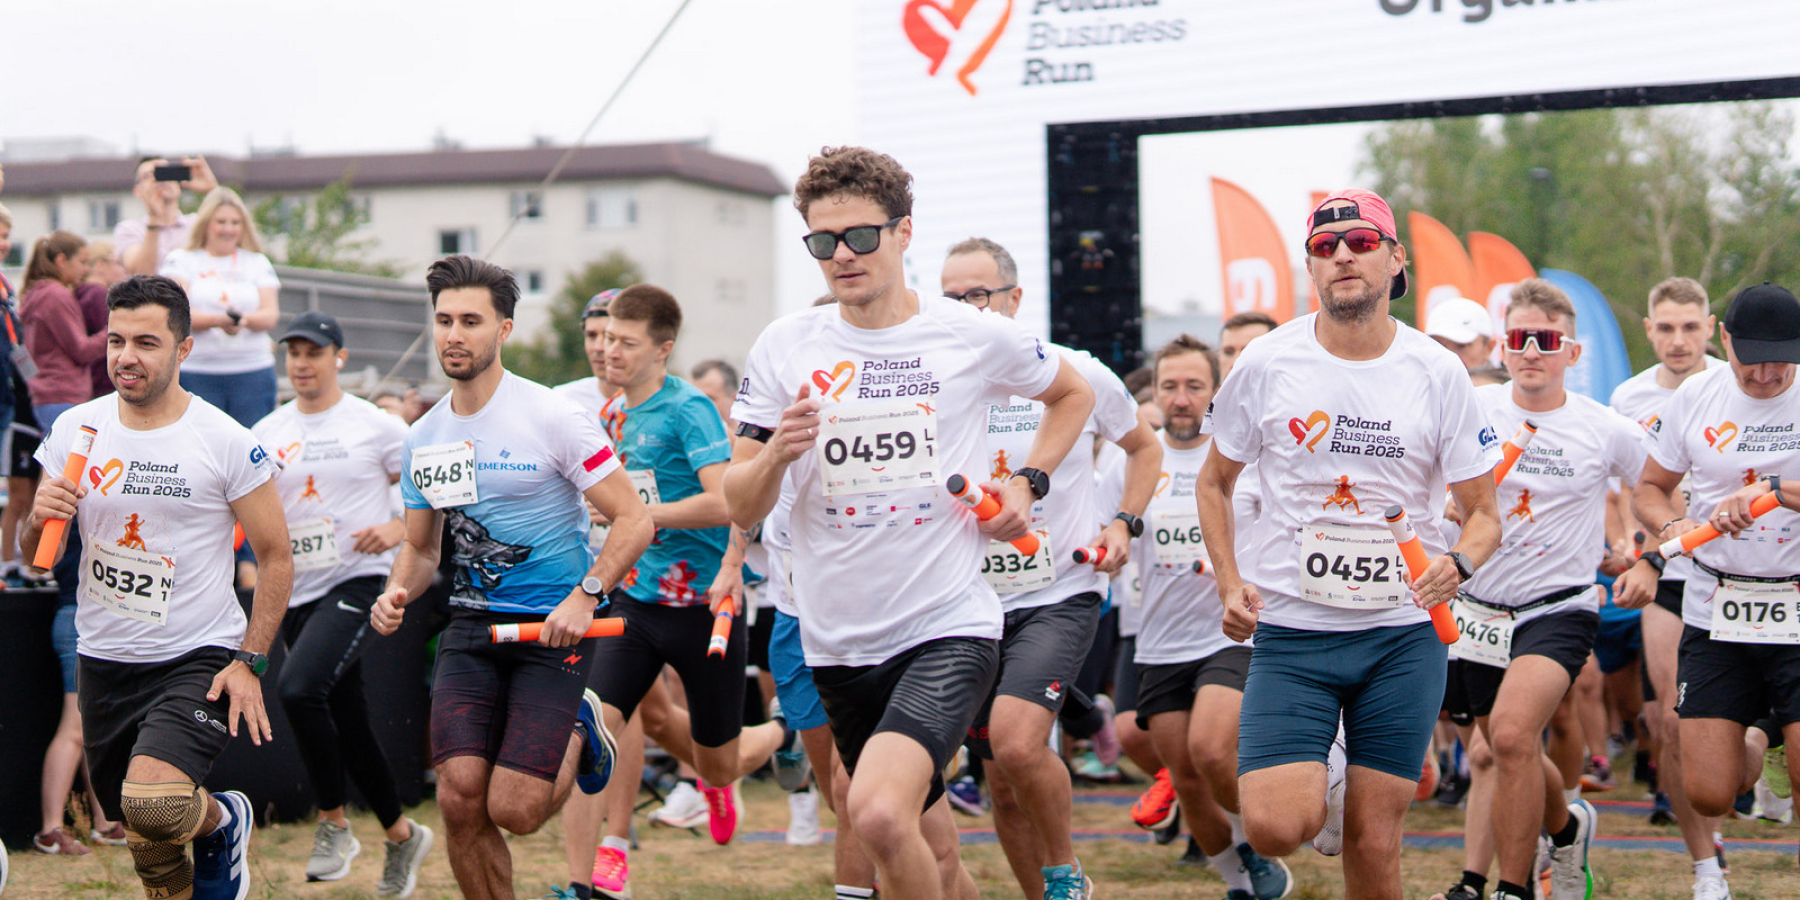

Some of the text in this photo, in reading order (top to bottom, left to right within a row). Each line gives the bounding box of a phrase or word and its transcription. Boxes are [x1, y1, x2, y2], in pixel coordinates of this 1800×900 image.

[1026, 18, 1188, 51] Business
[1022, 58, 1094, 85] Run
[862, 357, 921, 371] Poland
[860, 371, 933, 386] Business
[857, 381, 940, 399] Run 2025
[988, 421, 1039, 433] Run 202
[1335, 415, 1392, 431] Poland
[1743, 423, 1794, 433] Poland
[925, 428, 934, 441] L
[1332, 428, 1400, 445] Business
[825, 431, 916, 466] 0459
[926, 445, 933, 457] 1
[1329, 441, 1405, 459] Run 2025
[1737, 443, 1765, 452] Run
[128, 461, 178, 474] Poland
[465, 459, 474, 469] N
[478, 462, 537, 471] EMERSON
[1516, 464, 1575, 477] Run 2025
[125, 472, 186, 486] Business
[414, 462, 462, 490] 0548
[467, 471, 472, 481] 1
[121, 484, 192, 498] Run 2025
[1156, 526, 1202, 545] 046
[292, 535, 323, 555] 287
[1306, 552, 1389, 582] 0452
[1396, 555, 1403, 567] L
[92, 559, 153, 598] 0532
[161, 577, 171, 589] N
[1396, 570, 1402, 582] 1
[161, 590, 167, 602] 1
[1722, 600, 1787, 622] 0176
[1457, 617, 1501, 645] 0476
[1504, 640, 1508, 649] 1
